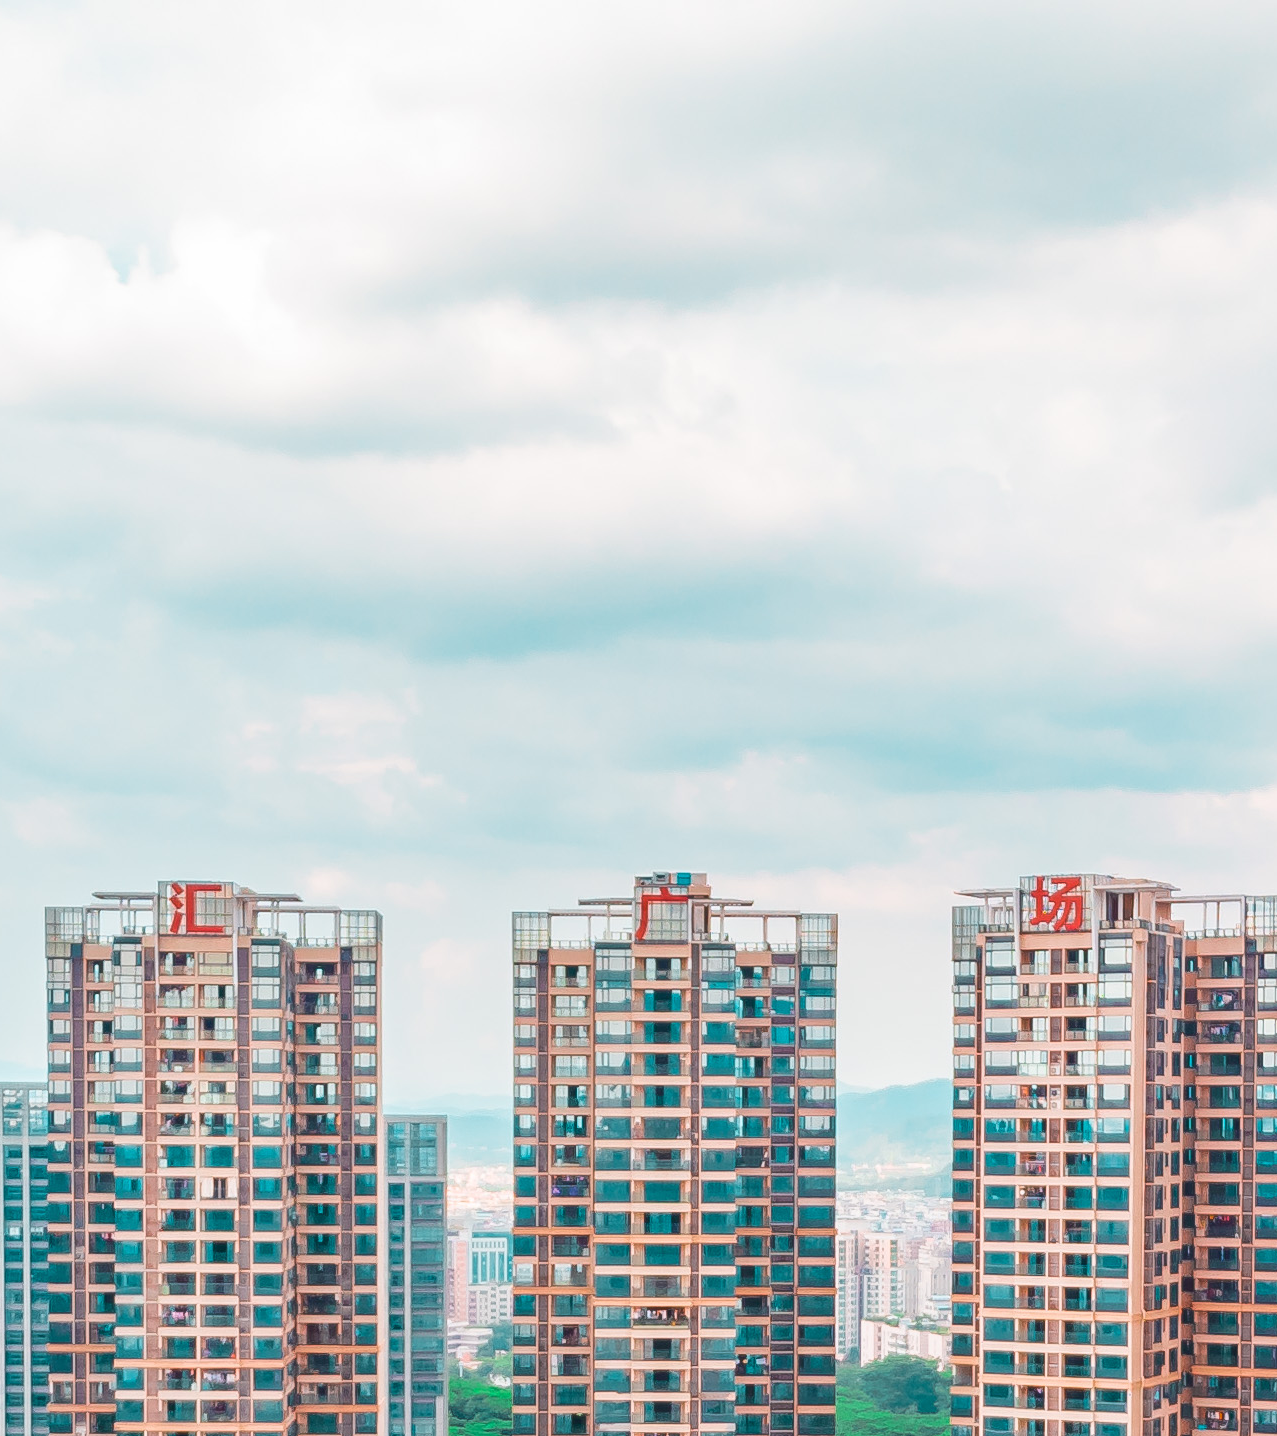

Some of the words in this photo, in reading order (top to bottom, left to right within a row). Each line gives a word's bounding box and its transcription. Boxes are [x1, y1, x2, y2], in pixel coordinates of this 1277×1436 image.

[169, 882, 224, 934] 汇
[635, 886, 689, 941] 广
[1030, 876, 1083, 931] 场
